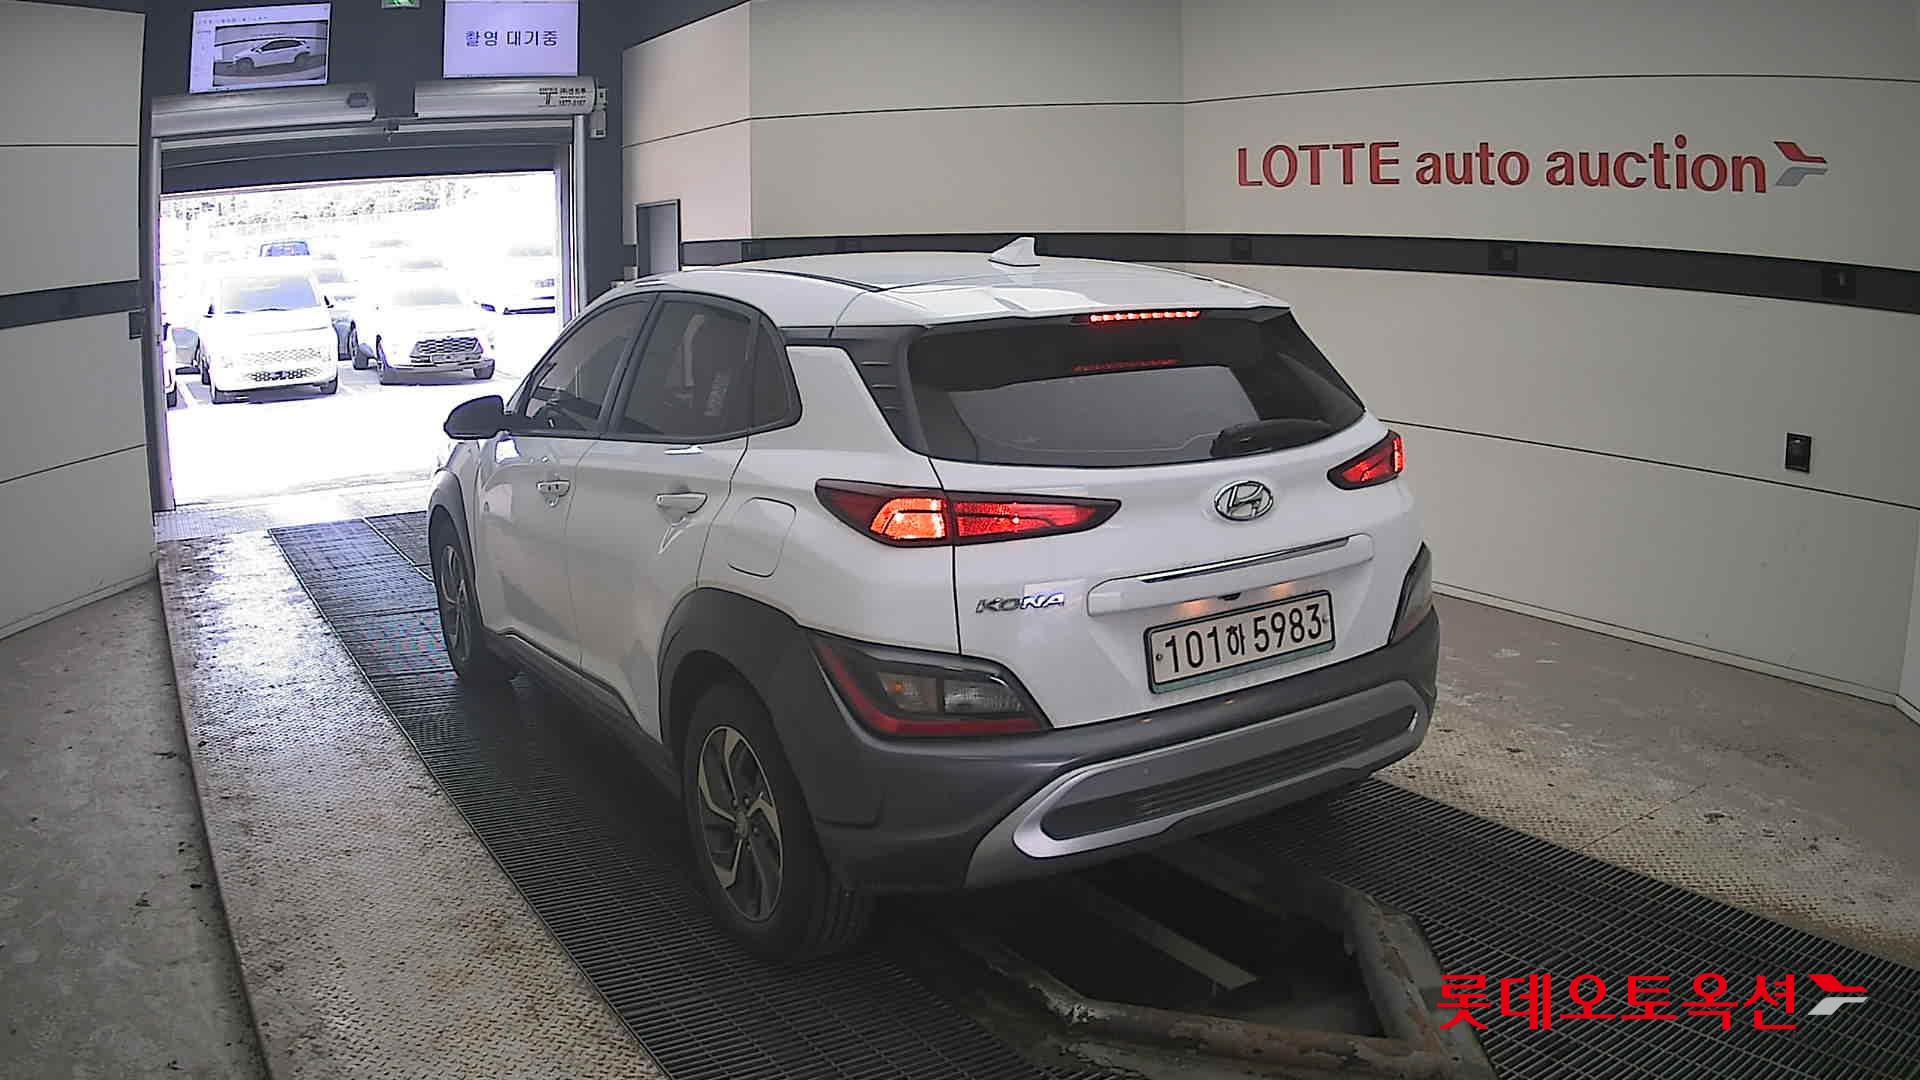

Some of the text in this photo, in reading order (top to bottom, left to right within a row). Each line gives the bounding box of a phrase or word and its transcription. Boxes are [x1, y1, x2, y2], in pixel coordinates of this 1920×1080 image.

[506, 31, 559, 47] 대기중
[1238, 134, 1767, 193] LOTTE auto auction
[975, 592, 1064, 613] KONA
